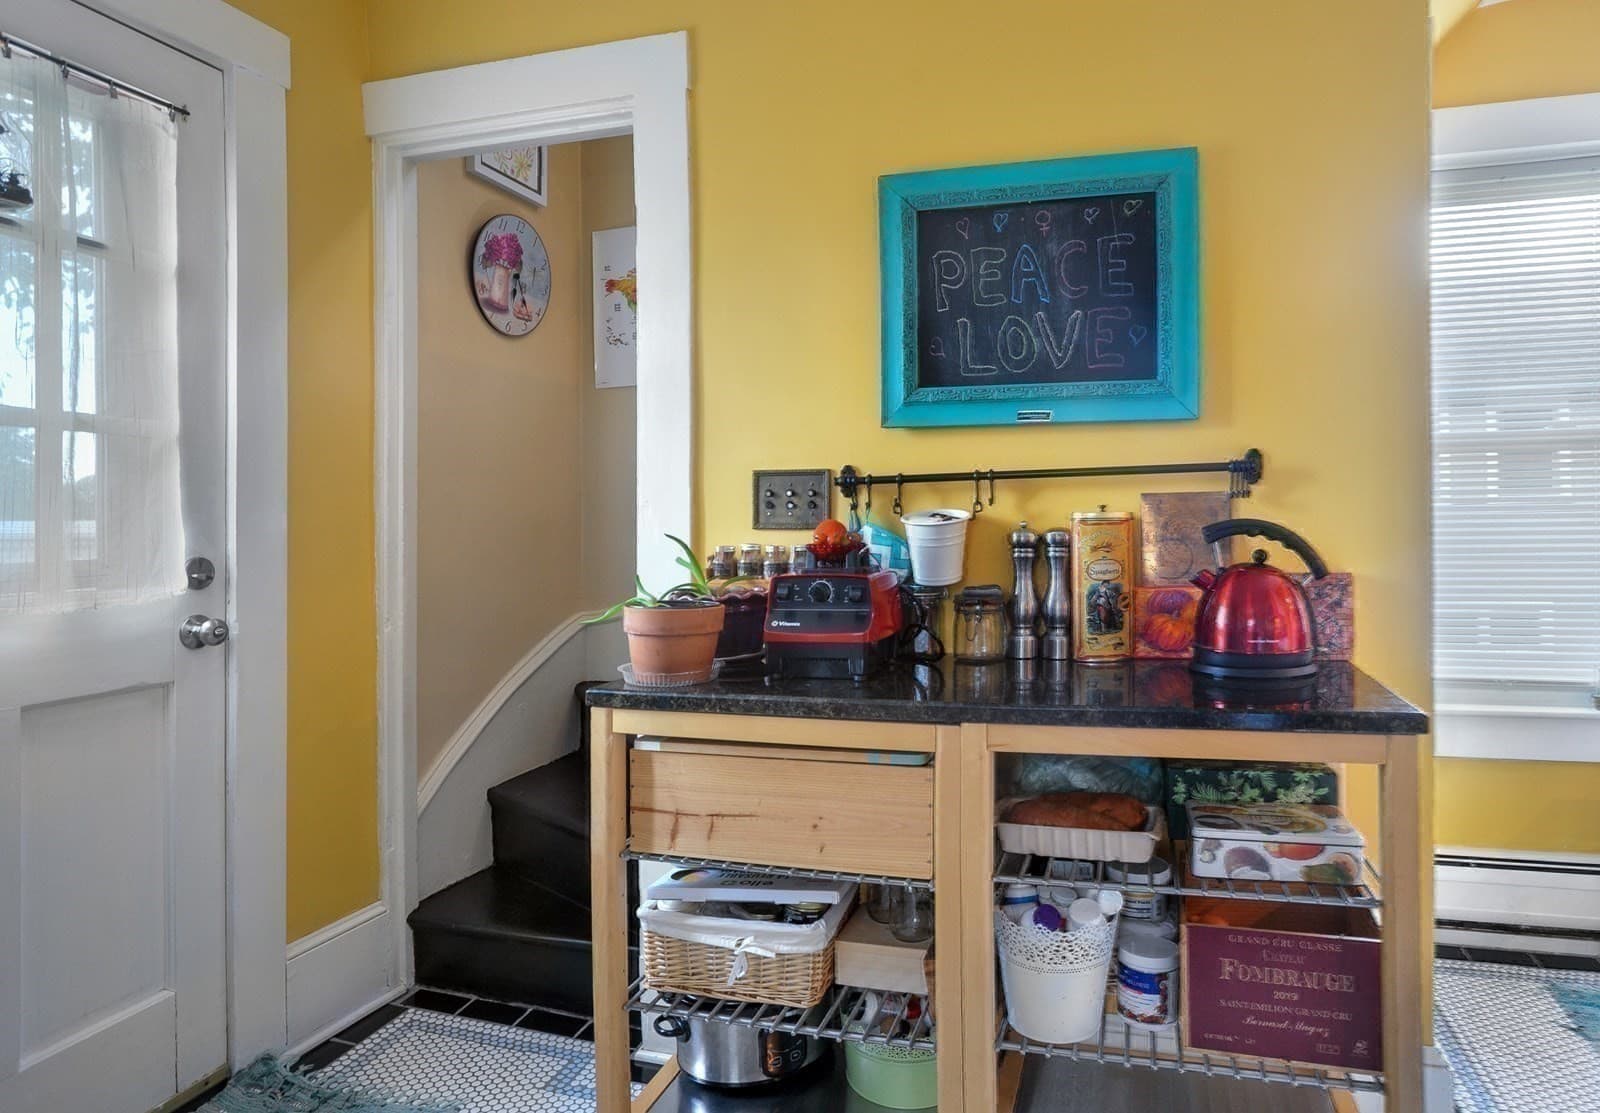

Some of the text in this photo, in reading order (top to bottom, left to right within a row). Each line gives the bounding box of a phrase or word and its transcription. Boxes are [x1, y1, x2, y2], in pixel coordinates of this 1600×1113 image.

[499, 218, 508, 231] 11
[516, 220, 526, 234] 12
[932, 232, 1136, 312] PEACE
[957, 306, 1131, 376] LOVE
[1227, 934, 1270, 945] GRAND
[1272, 938, 1296, 948] CRU
[1218, 957, 1355, 993] FOMBRAUGE
